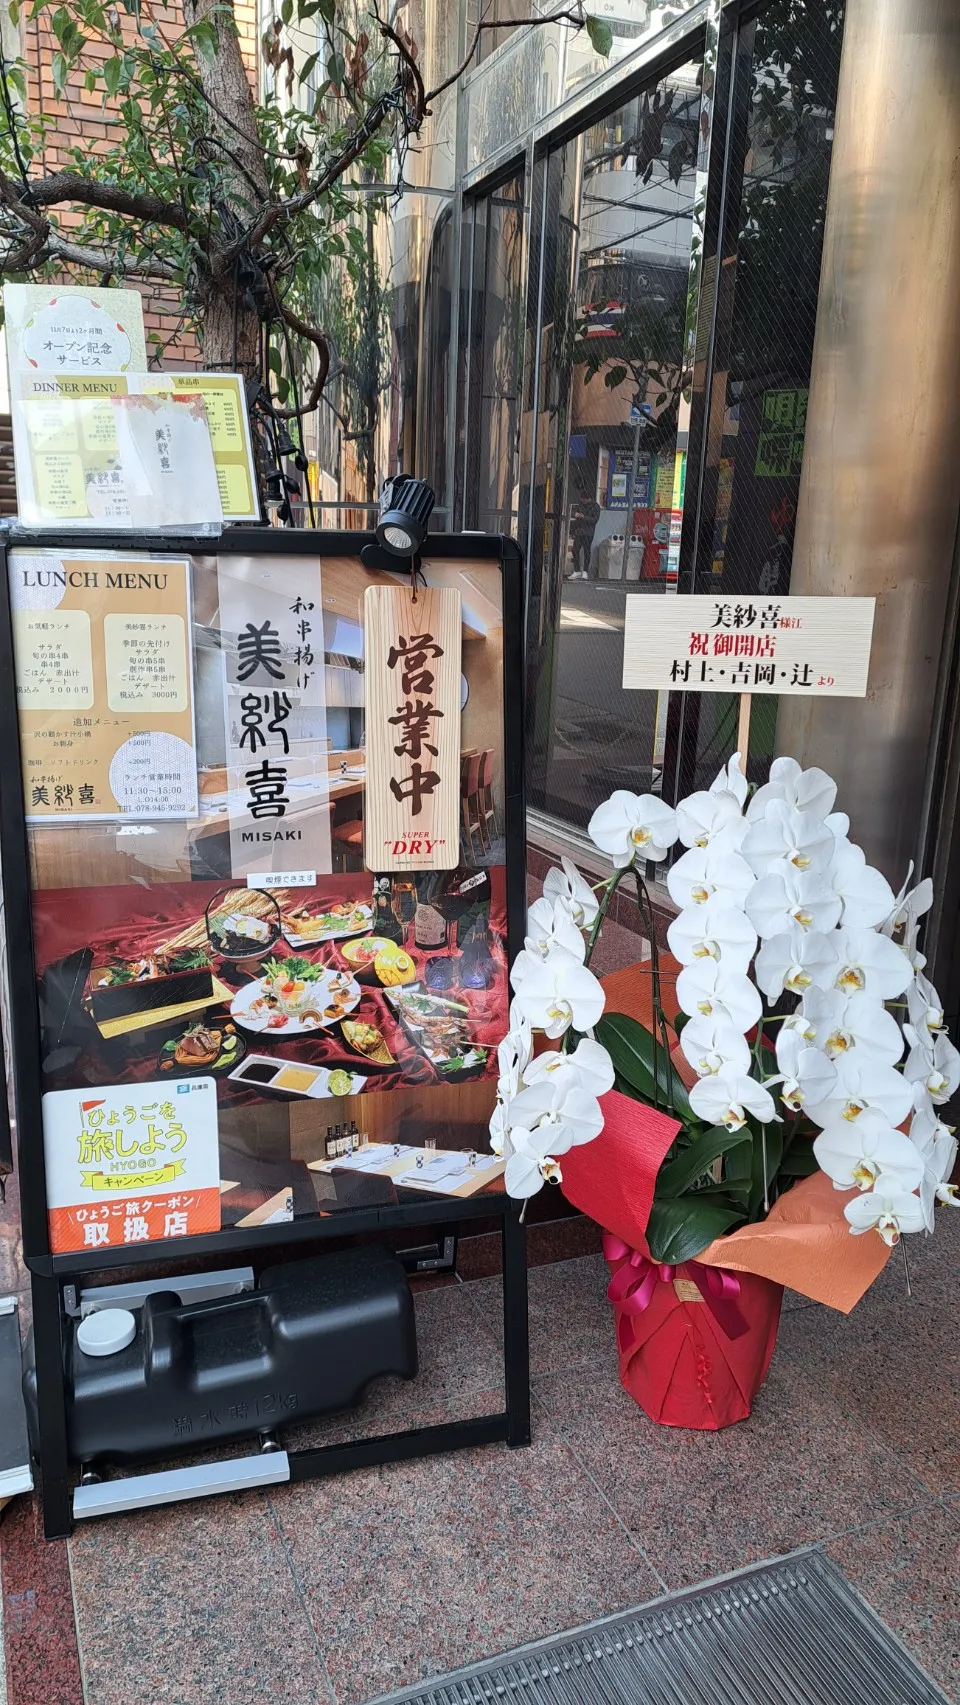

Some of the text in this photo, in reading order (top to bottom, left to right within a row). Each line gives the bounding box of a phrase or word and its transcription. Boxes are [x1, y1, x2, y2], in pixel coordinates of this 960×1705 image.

[42, 340, 113, 355] オープン記念
[56, 354, 102, 366] サービス
[33, 382, 118, 393] DINNER MENU
[22, 570, 168, 590] LUNCH MENU
[28, 622, 70, 630] お気軽ランチ
[38, 643, 63, 651] サラダ
[122, 640, 171, 648] 季節の先付け
[289, 596, 315, 691] 和串揚げ
[135, 648, 160, 656] サラダ
[23, 669, 47, 677] ごはん
[121, 674, 144, 682] ごはん
[134, 682, 165, 690] デザート
[119, 691, 144, 699] 税込み
[73, 716, 131, 727] 追加メニュー
[236, 620, 293, 819] 美紗喜
[386, 632, 444, 817] 営業中
[125, 773, 181, 781] ランチ営業時間
[241, 829, 302, 842] MISAKI
[402, 831, 429, 839] SUPER
[265, 874, 313, 885] 喫煙できます
[88, 1101, 176, 1128] ひょうごを
[76, 1122, 188, 1164] 旅しよう
[110, 1157, 157, 1172] HYOGO
[103, 1172, 164, 1188] キャンペーン
[75, 1195, 195, 1222] ひょうご旅クーポン
[83, 1211, 189, 1248] 取扱店
